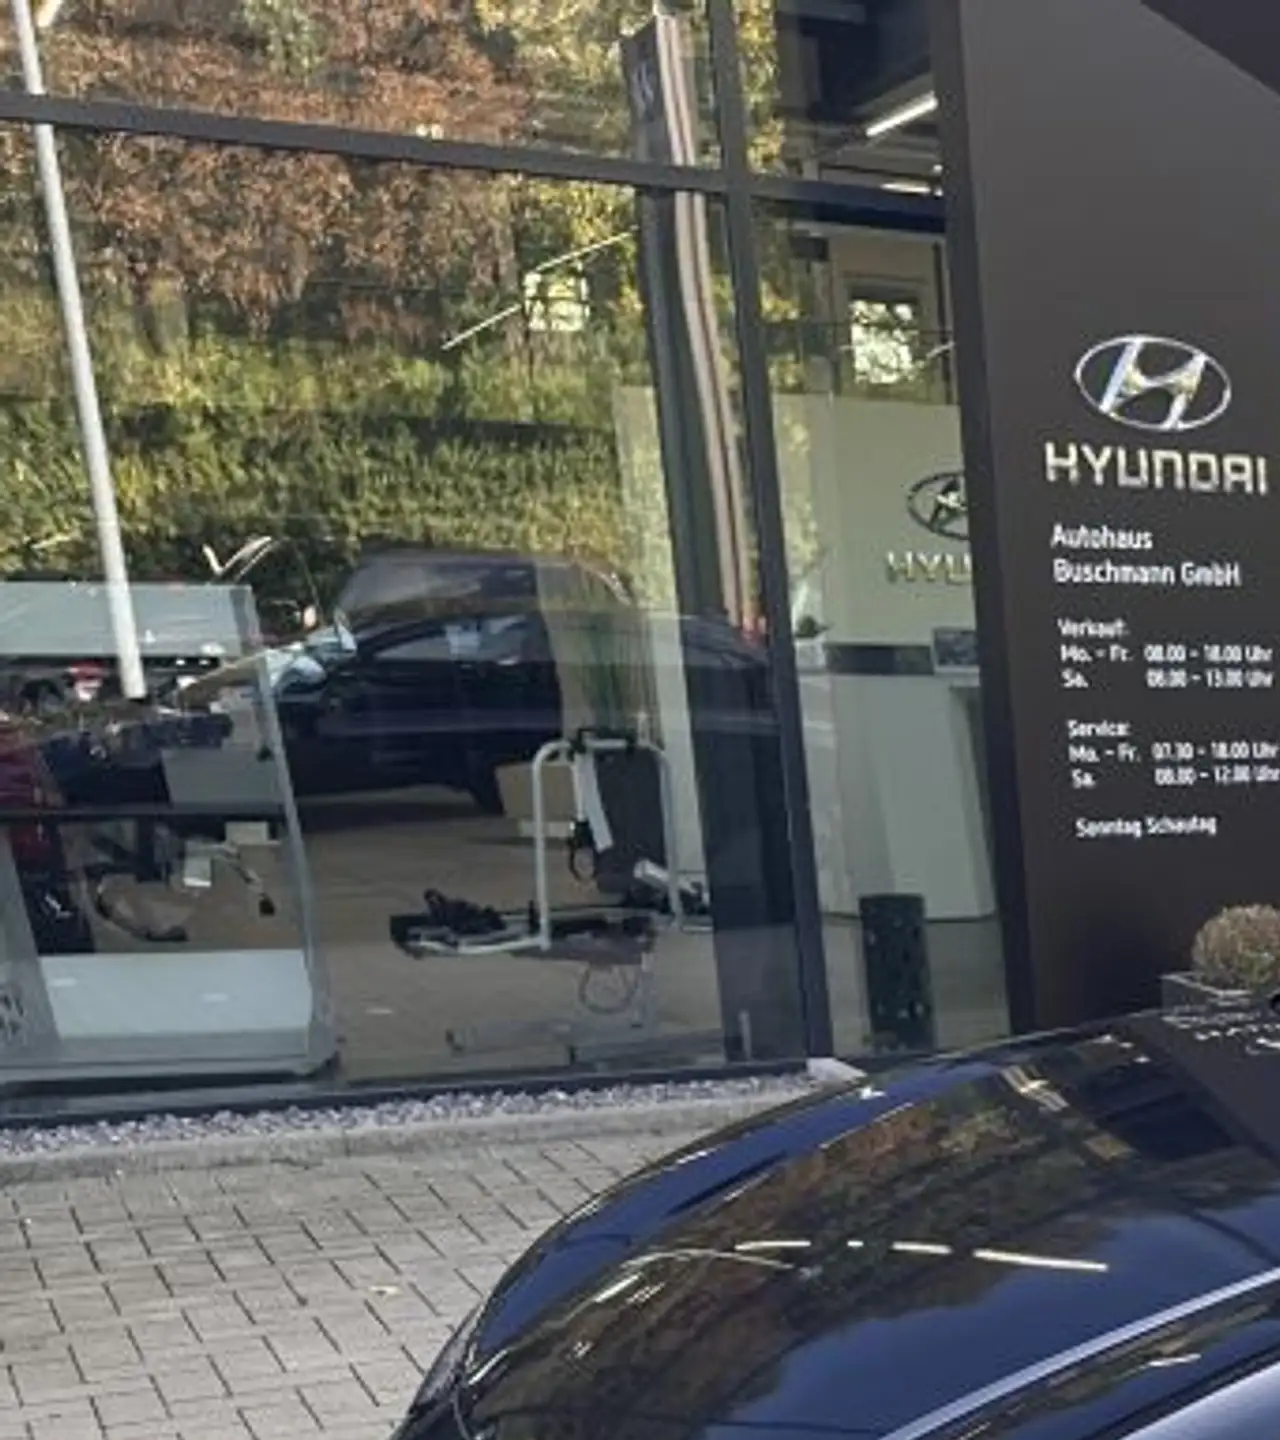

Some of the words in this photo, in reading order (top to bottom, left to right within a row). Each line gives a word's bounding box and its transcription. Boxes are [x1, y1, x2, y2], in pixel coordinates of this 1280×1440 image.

[1043, 440, 1268, 496] HYUNDAI
[1050, 523, 1154, 549] Autohaus
[886, 551, 973, 585] HYU
[1052, 558, 1175, 585] Buschmann
[1180, 561, 1243, 588] GmbH
